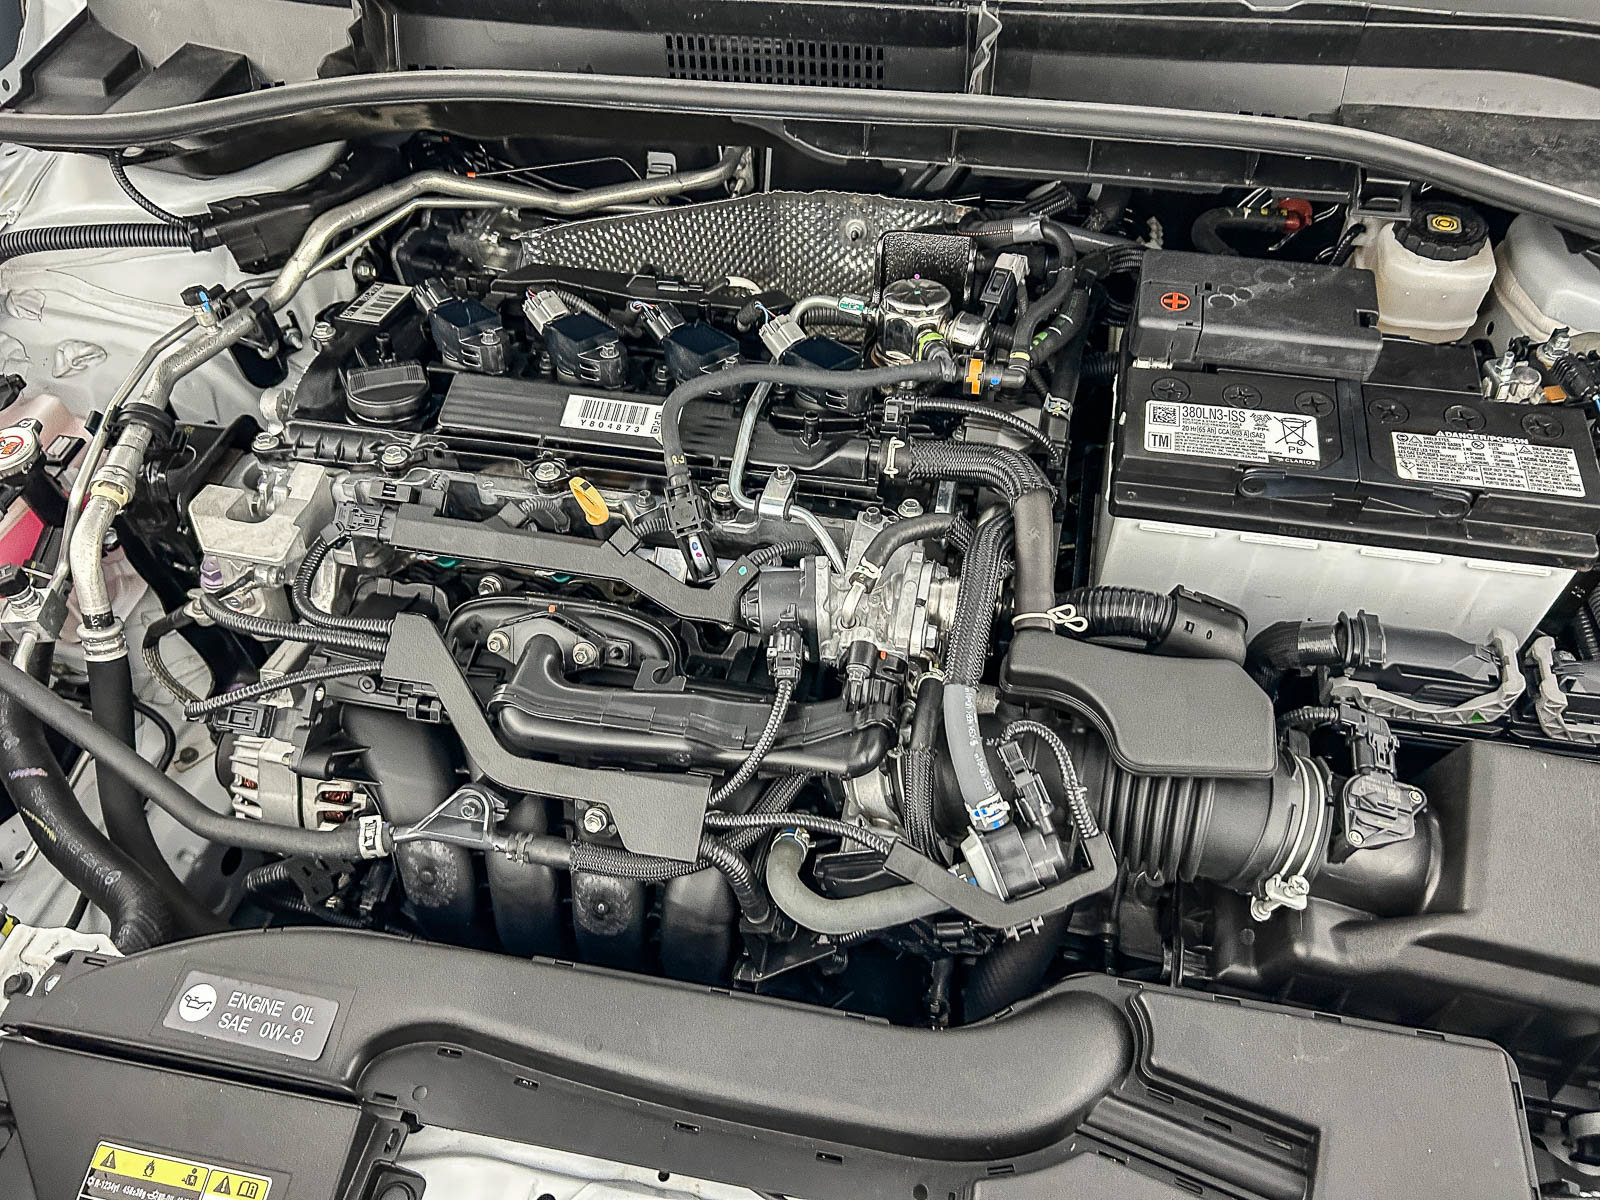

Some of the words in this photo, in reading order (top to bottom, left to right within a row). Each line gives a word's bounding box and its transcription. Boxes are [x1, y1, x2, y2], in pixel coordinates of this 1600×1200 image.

[1182, 405, 1246, 422] 380LN3-ISS
[580, 419, 640, 433] Y804873
[1151, 433, 1169, 448] TM
[1288, 445, 1304, 454] Pb
[1285, 457, 1316, 466] CLARIOS
[228, 991, 286, 1017] ENGINE
[291, 1005, 315, 1025] OIL
[218, 1012, 252, 1033] SAE
[259, 1022, 304, 1045] 0W-8
